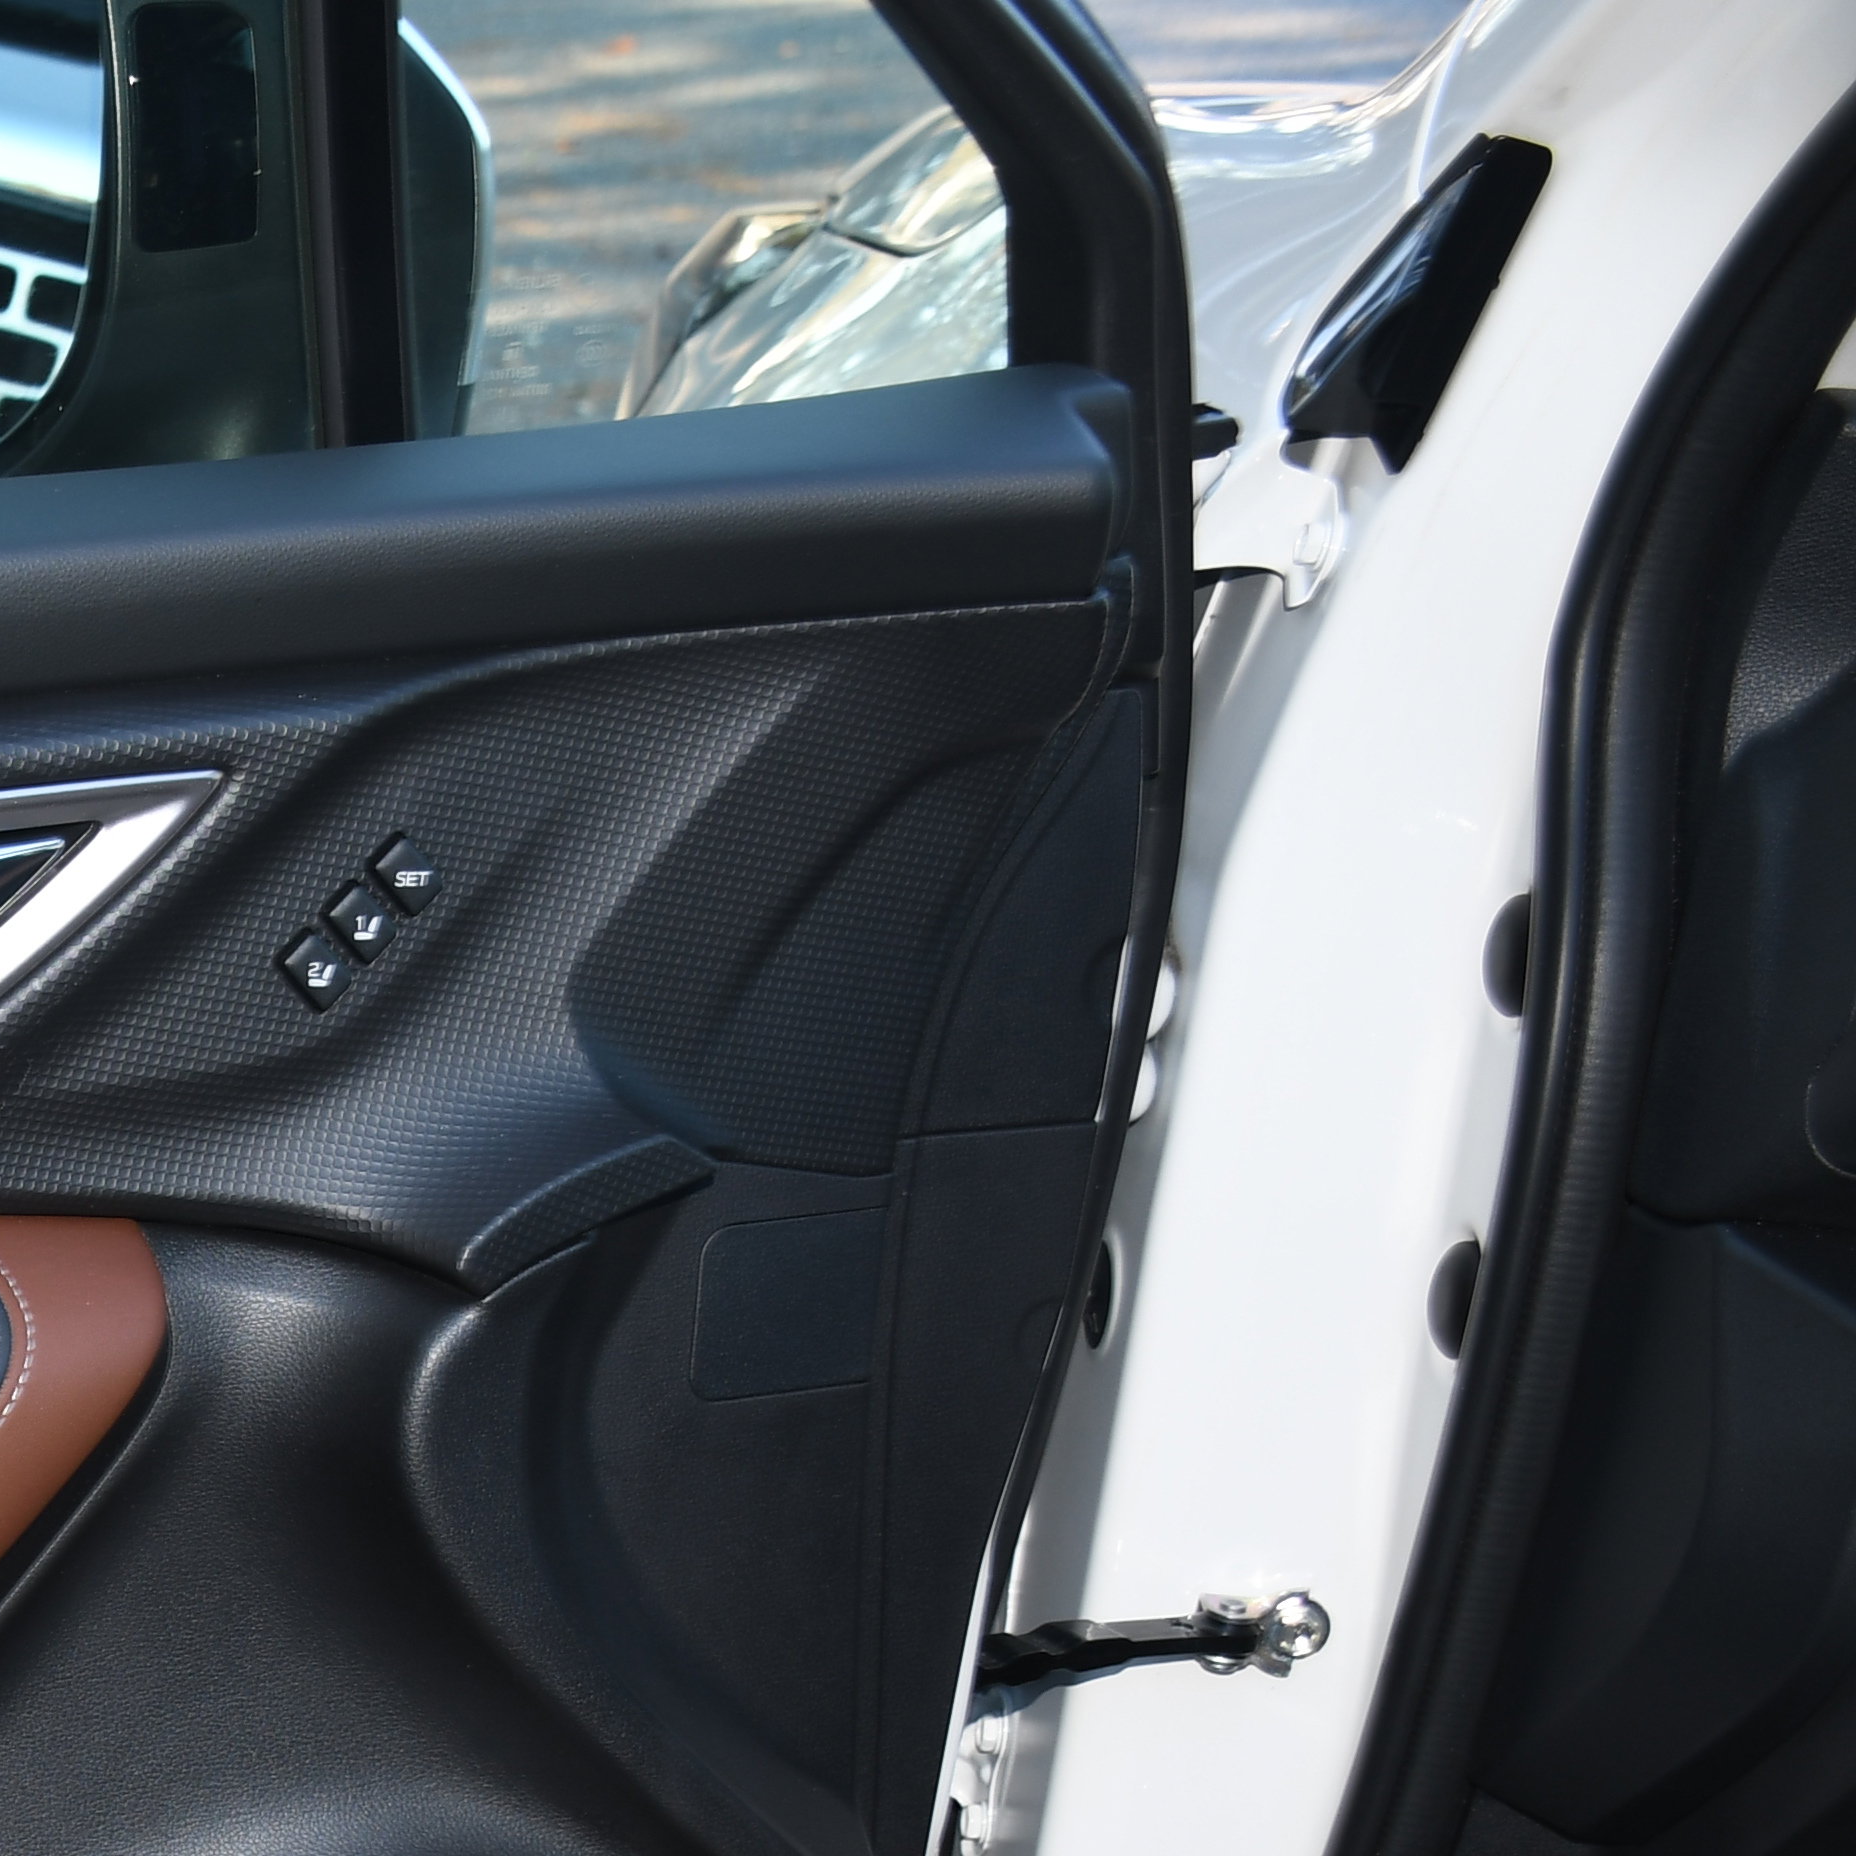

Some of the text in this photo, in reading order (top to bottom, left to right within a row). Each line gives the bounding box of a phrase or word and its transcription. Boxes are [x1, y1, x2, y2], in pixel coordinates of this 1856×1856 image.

[394, 870, 434, 888] SET
[355, 914, 367, 931] 1
[307, 961, 324, 978] 2
